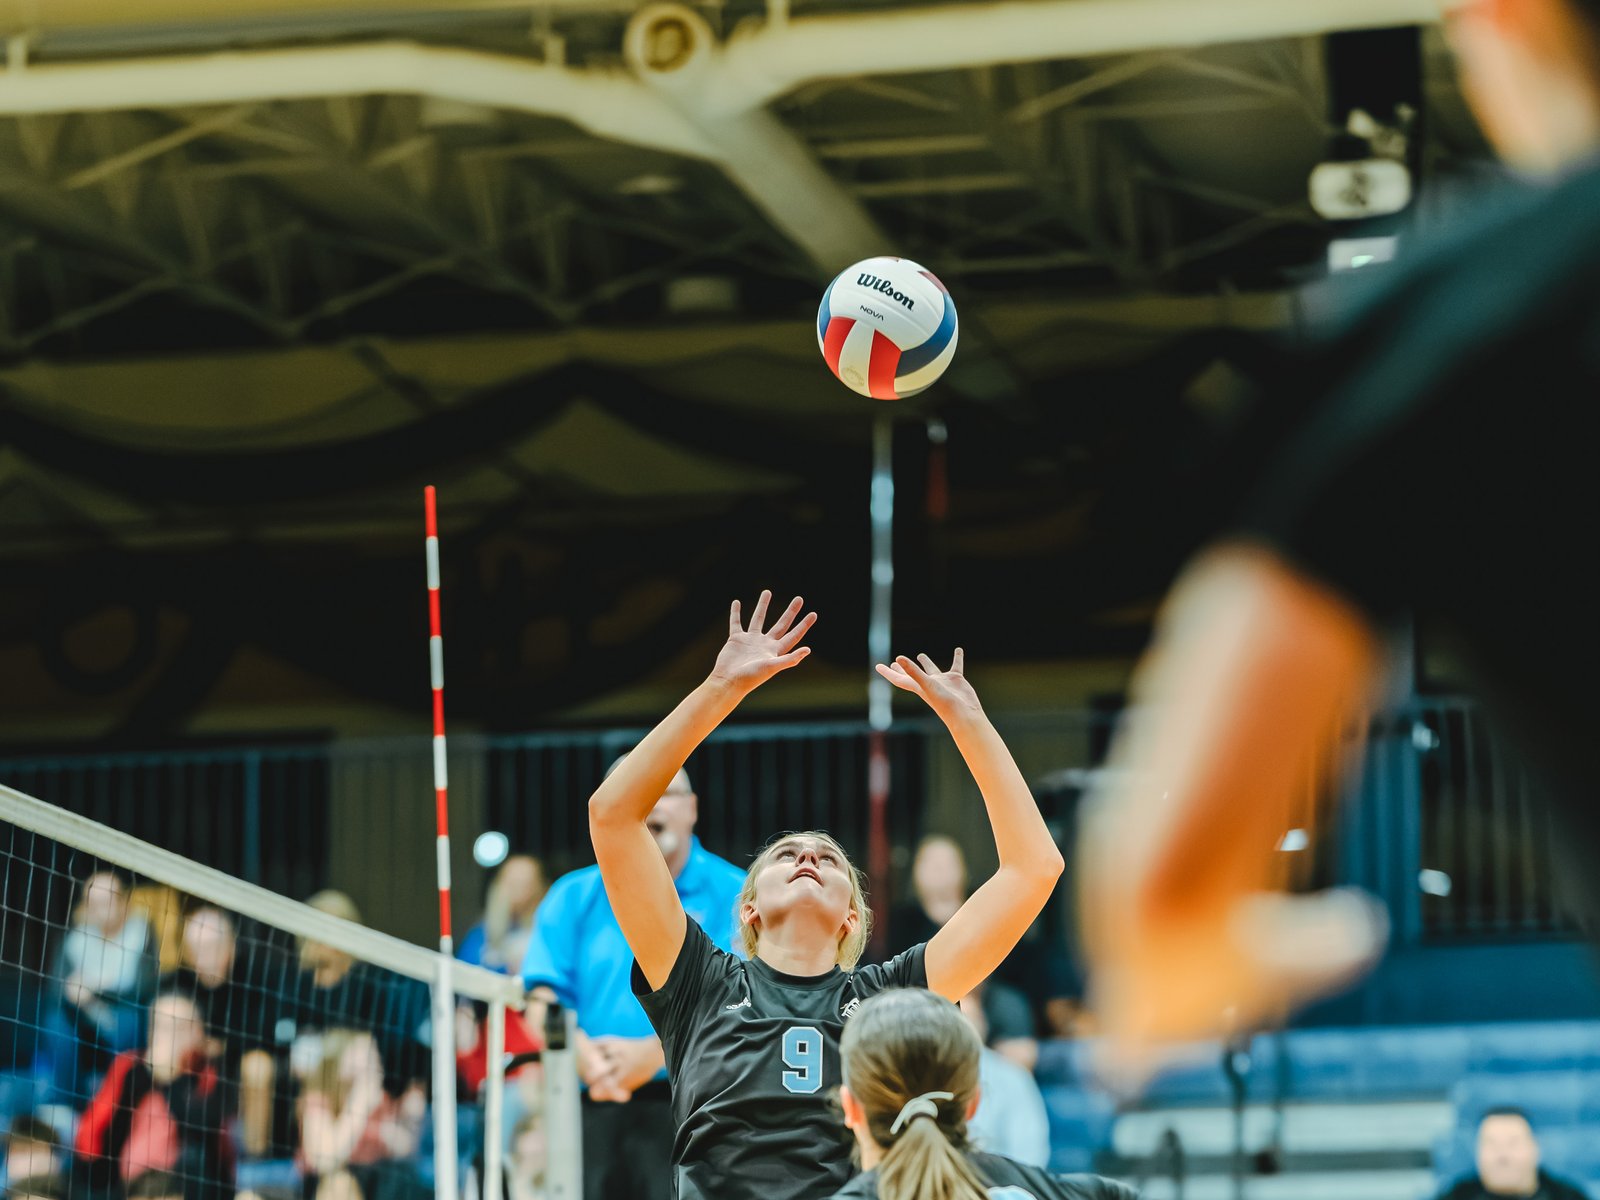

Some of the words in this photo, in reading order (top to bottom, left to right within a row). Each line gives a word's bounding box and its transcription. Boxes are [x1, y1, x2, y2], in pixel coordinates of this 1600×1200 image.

[857, 272, 915, 311] Wilson
[860, 305, 885, 321] NOVA
[782, 1026, 823, 1094] 9
